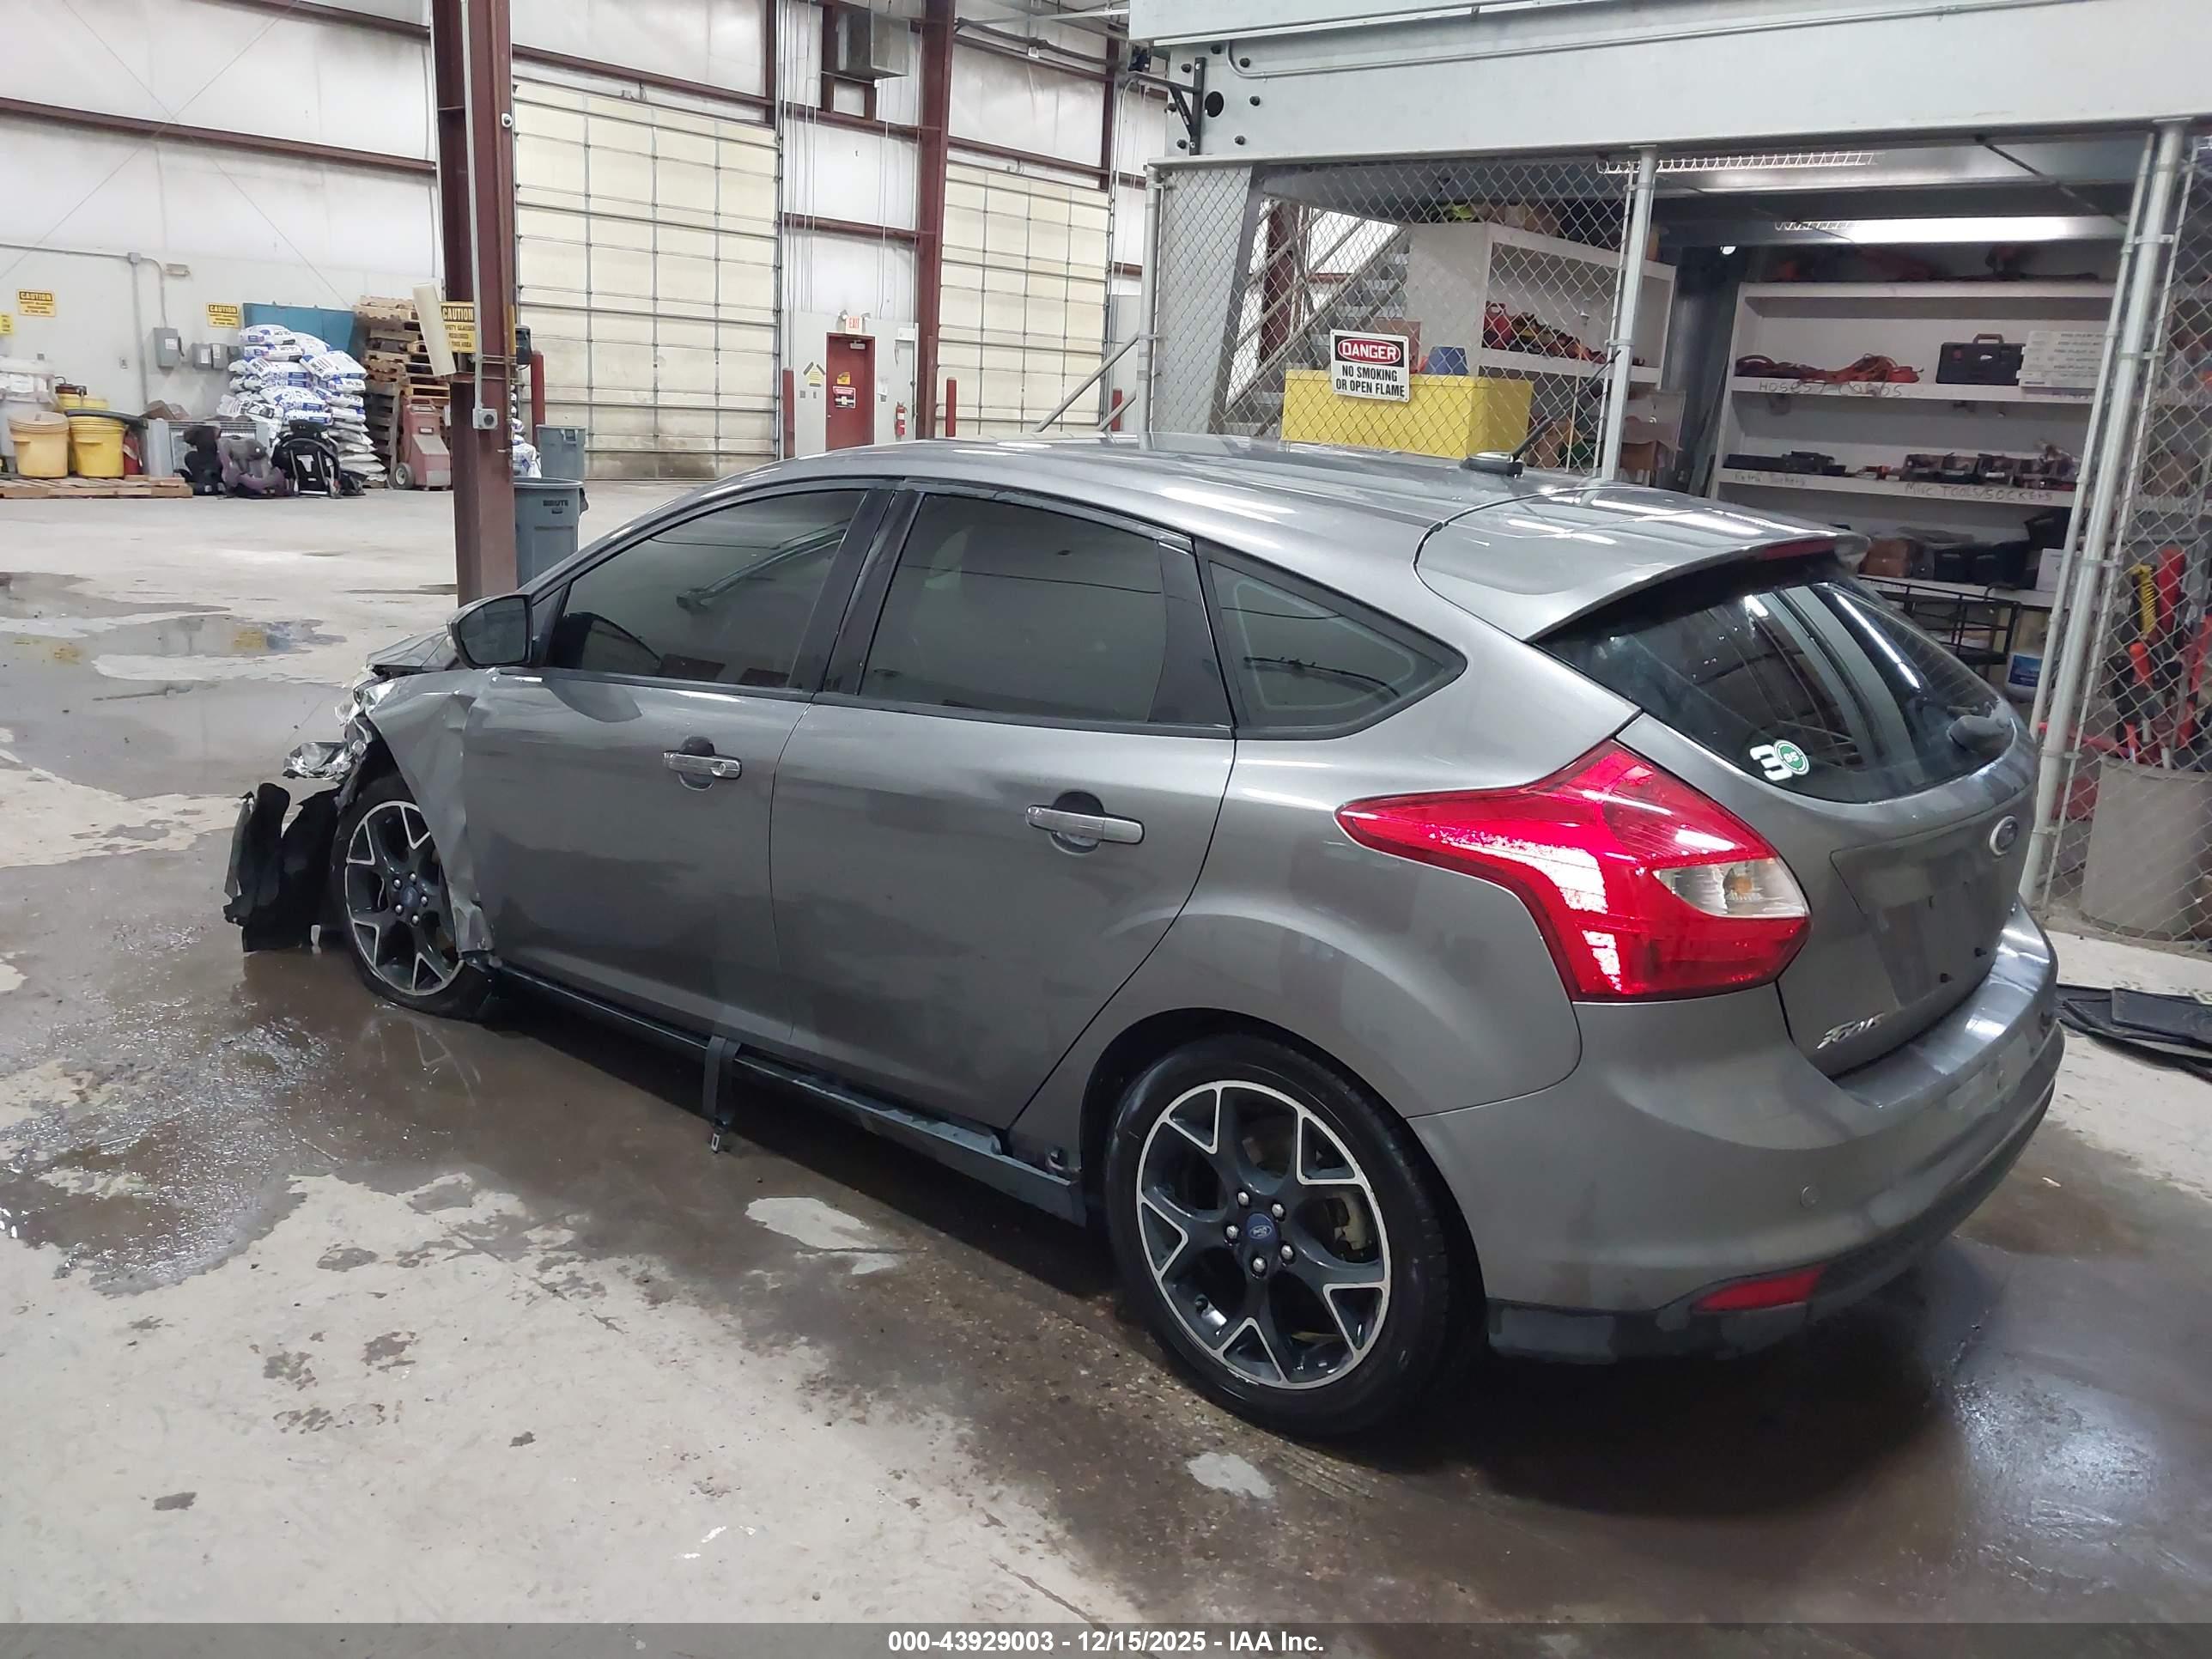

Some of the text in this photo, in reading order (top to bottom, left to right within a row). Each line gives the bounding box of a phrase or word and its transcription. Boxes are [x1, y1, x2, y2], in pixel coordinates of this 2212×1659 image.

[21, 292, 52, 301] CAUTION
[442, 307, 474, 320] CAUTION
[848, 318, 860, 329] EXIT
[1342, 342, 1397, 361] DANGER
[1342, 364, 1398, 382] NO SMOKING
[1336, 378, 1405, 398] OR OPEN FLAME
